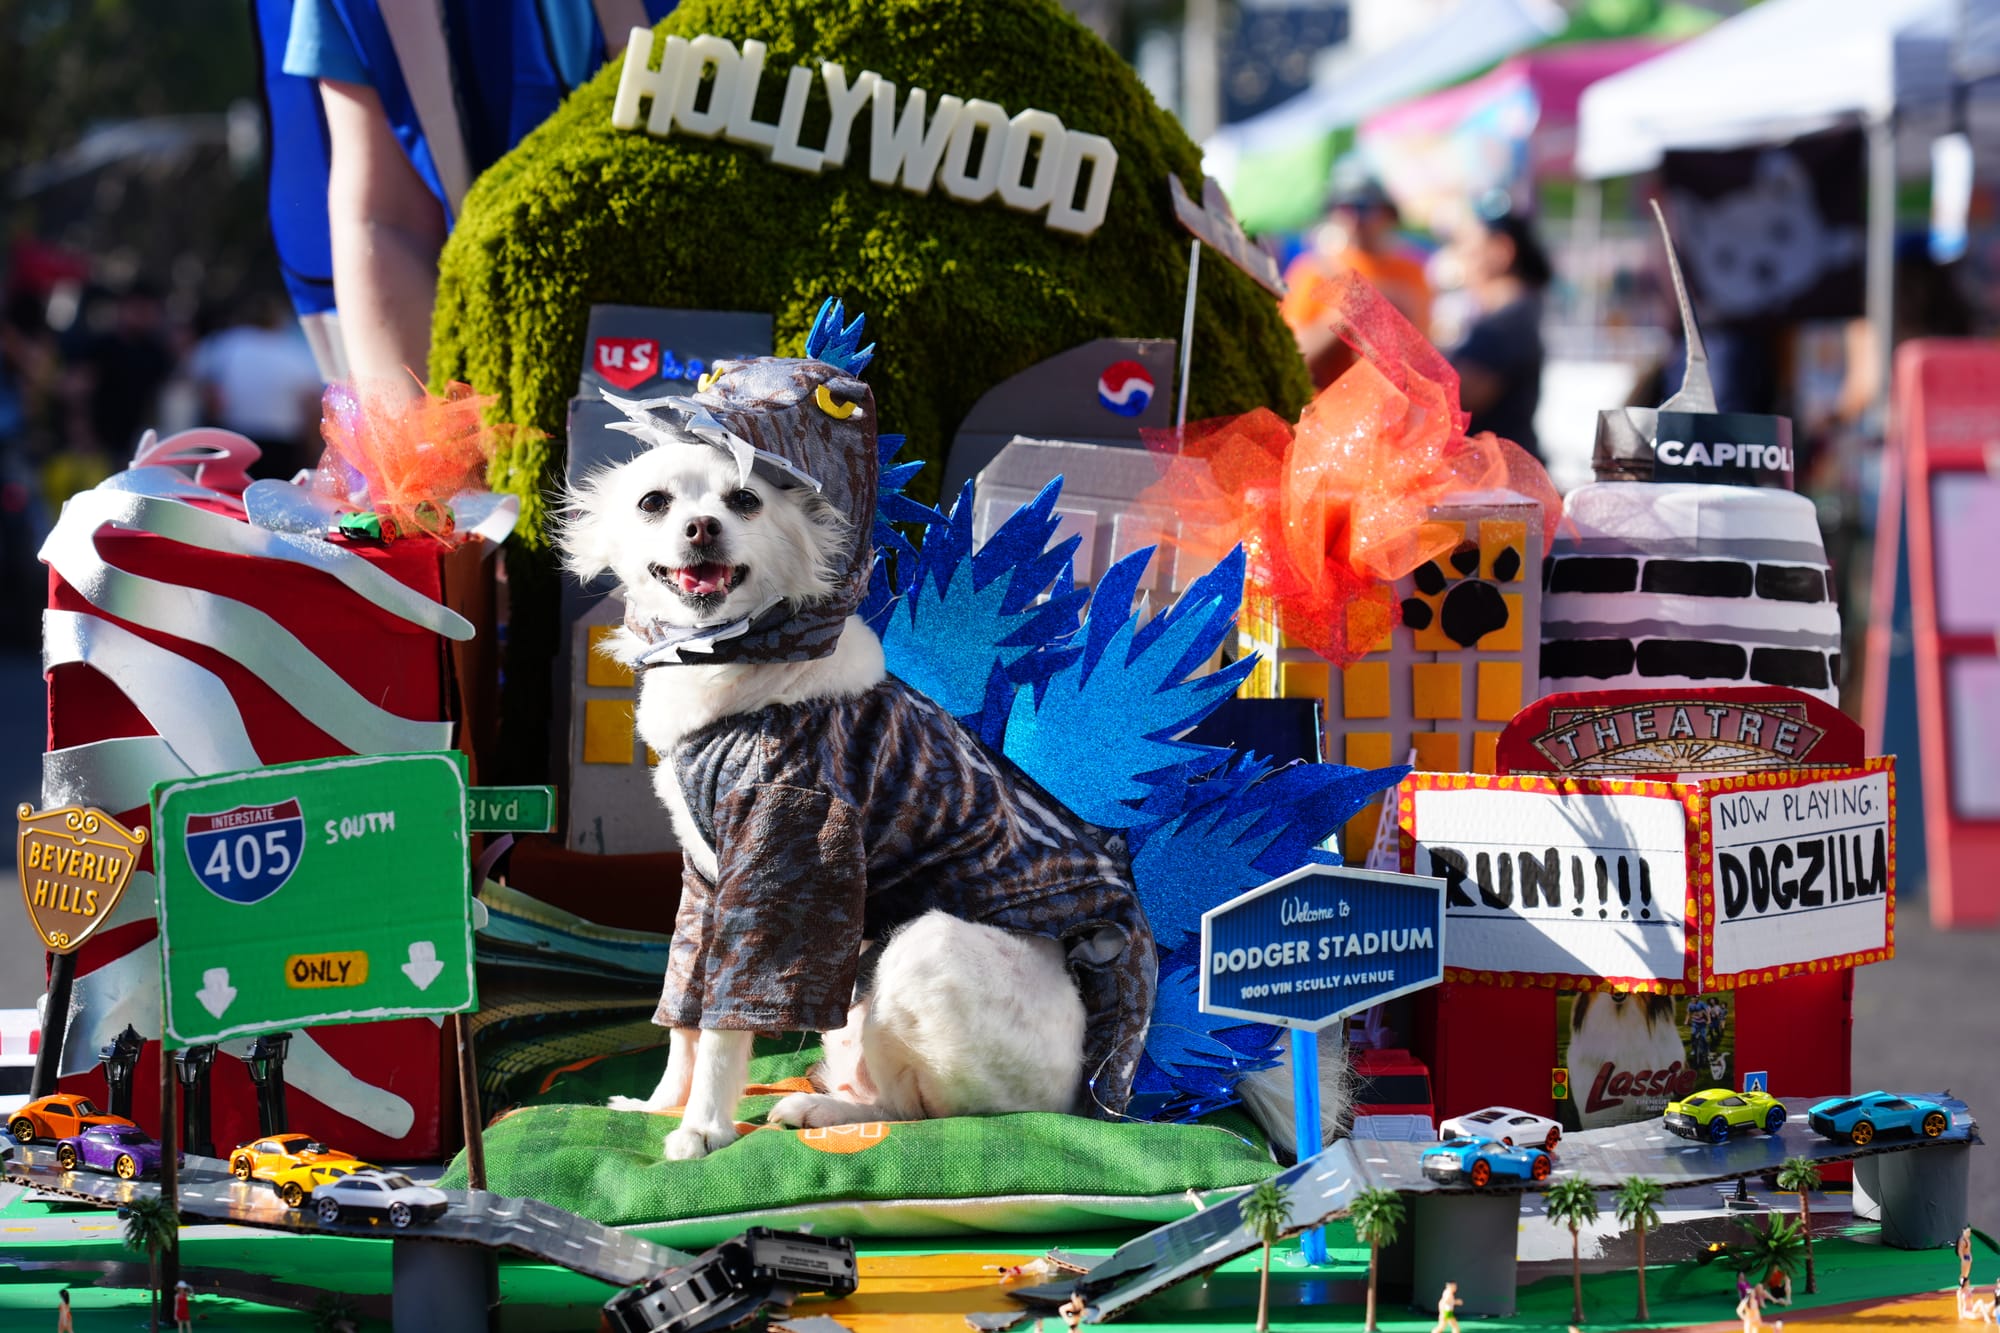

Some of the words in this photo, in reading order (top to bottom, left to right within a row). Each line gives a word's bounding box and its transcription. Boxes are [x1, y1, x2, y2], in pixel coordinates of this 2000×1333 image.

[612, 27, 1118, 237] HOLLYWOOD
[1557, 706, 1800, 761] THEATRE
[211, 808, 275, 829] INTERSTATE
[324, 811, 396, 844] SOUTH
[1720, 796, 1769, 830] NOW
[1783, 785, 1879, 821] PLAYING:
[28, 841, 121, 884] BEVERLY
[204, 830, 291, 883] 405
[1719, 828, 1886, 918] DOGZILLA
[34, 879, 98, 917] HILLS
[1428, 847, 1651, 919] RUN!!!!
[1281, 896, 1334, 926] Welcome
[1339, 899, 1351, 917] to
[293, 959, 352, 983] ONLY
[1213, 940, 1310, 975] DODGER
[1318, 927, 1434, 961] STADIUM
[1241, 985, 1269, 1000] 1000
[1271, 981, 1292, 995] VIN
[1296, 975, 1341, 991] SCULLY
[1343, 970, 1395, 985] AVENUE
[1585, 1060, 1697, 1114] Lassie
